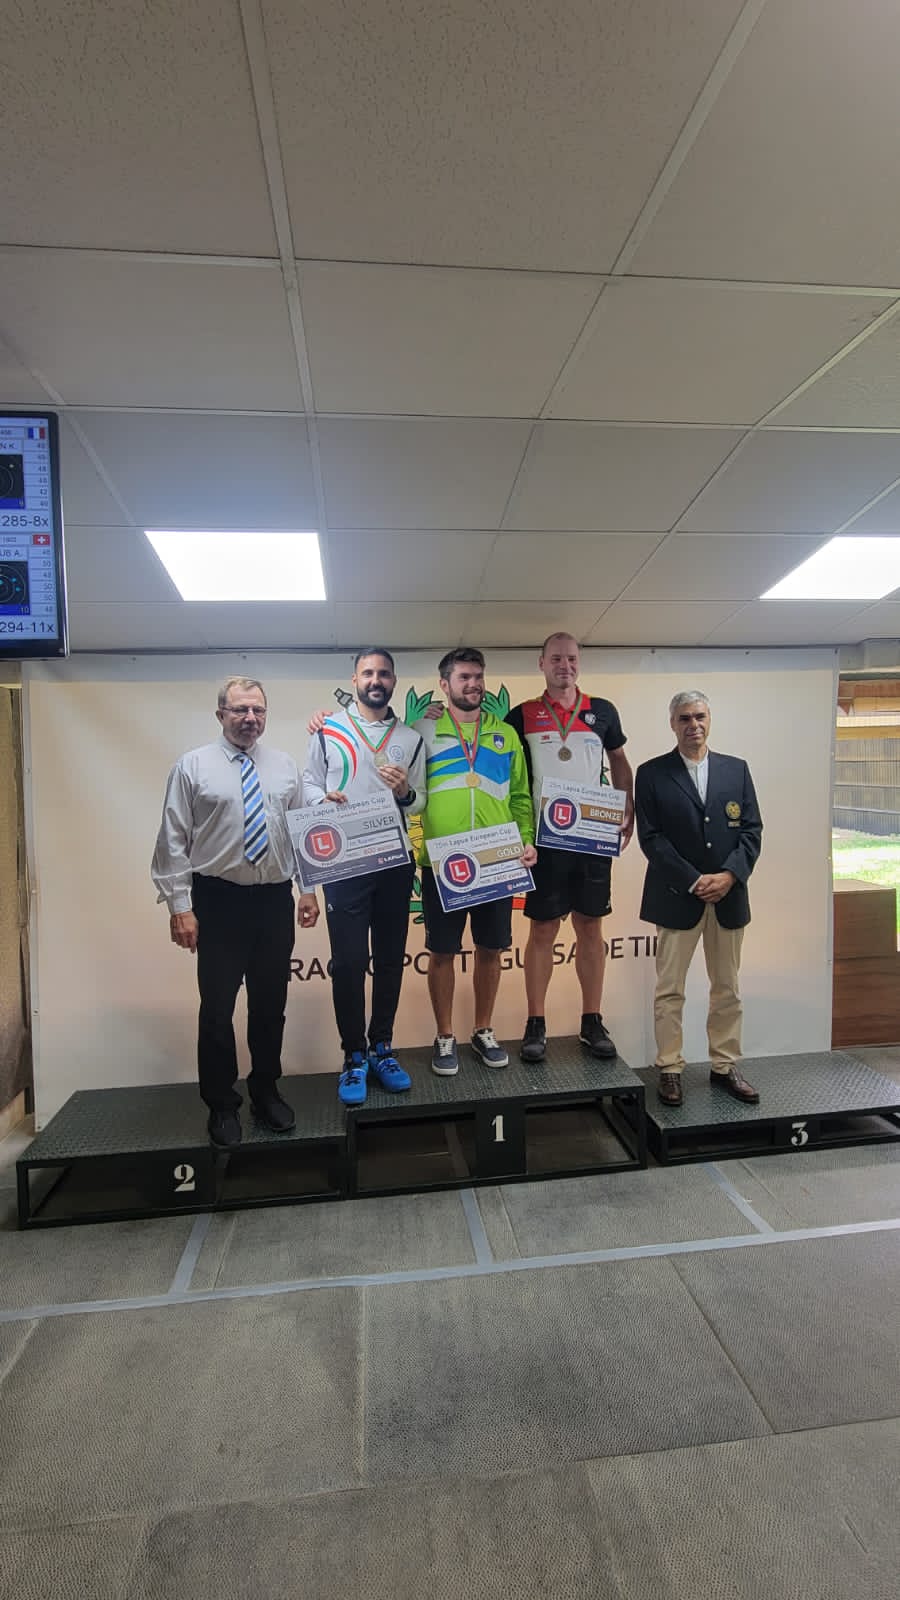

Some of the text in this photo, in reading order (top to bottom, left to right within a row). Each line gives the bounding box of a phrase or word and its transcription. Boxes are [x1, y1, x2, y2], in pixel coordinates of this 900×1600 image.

[0, 621, 55, 633] 294-11x
[590, 807, 622, 820] BRONZE
[363, 815, 395, 830] SILVER
[496, 846, 520, 858] GOLD
[491, 1115, 506, 1142] 1
[791, 1122, 809, 1146] 3
[173, 1164, 196, 1192] 2
